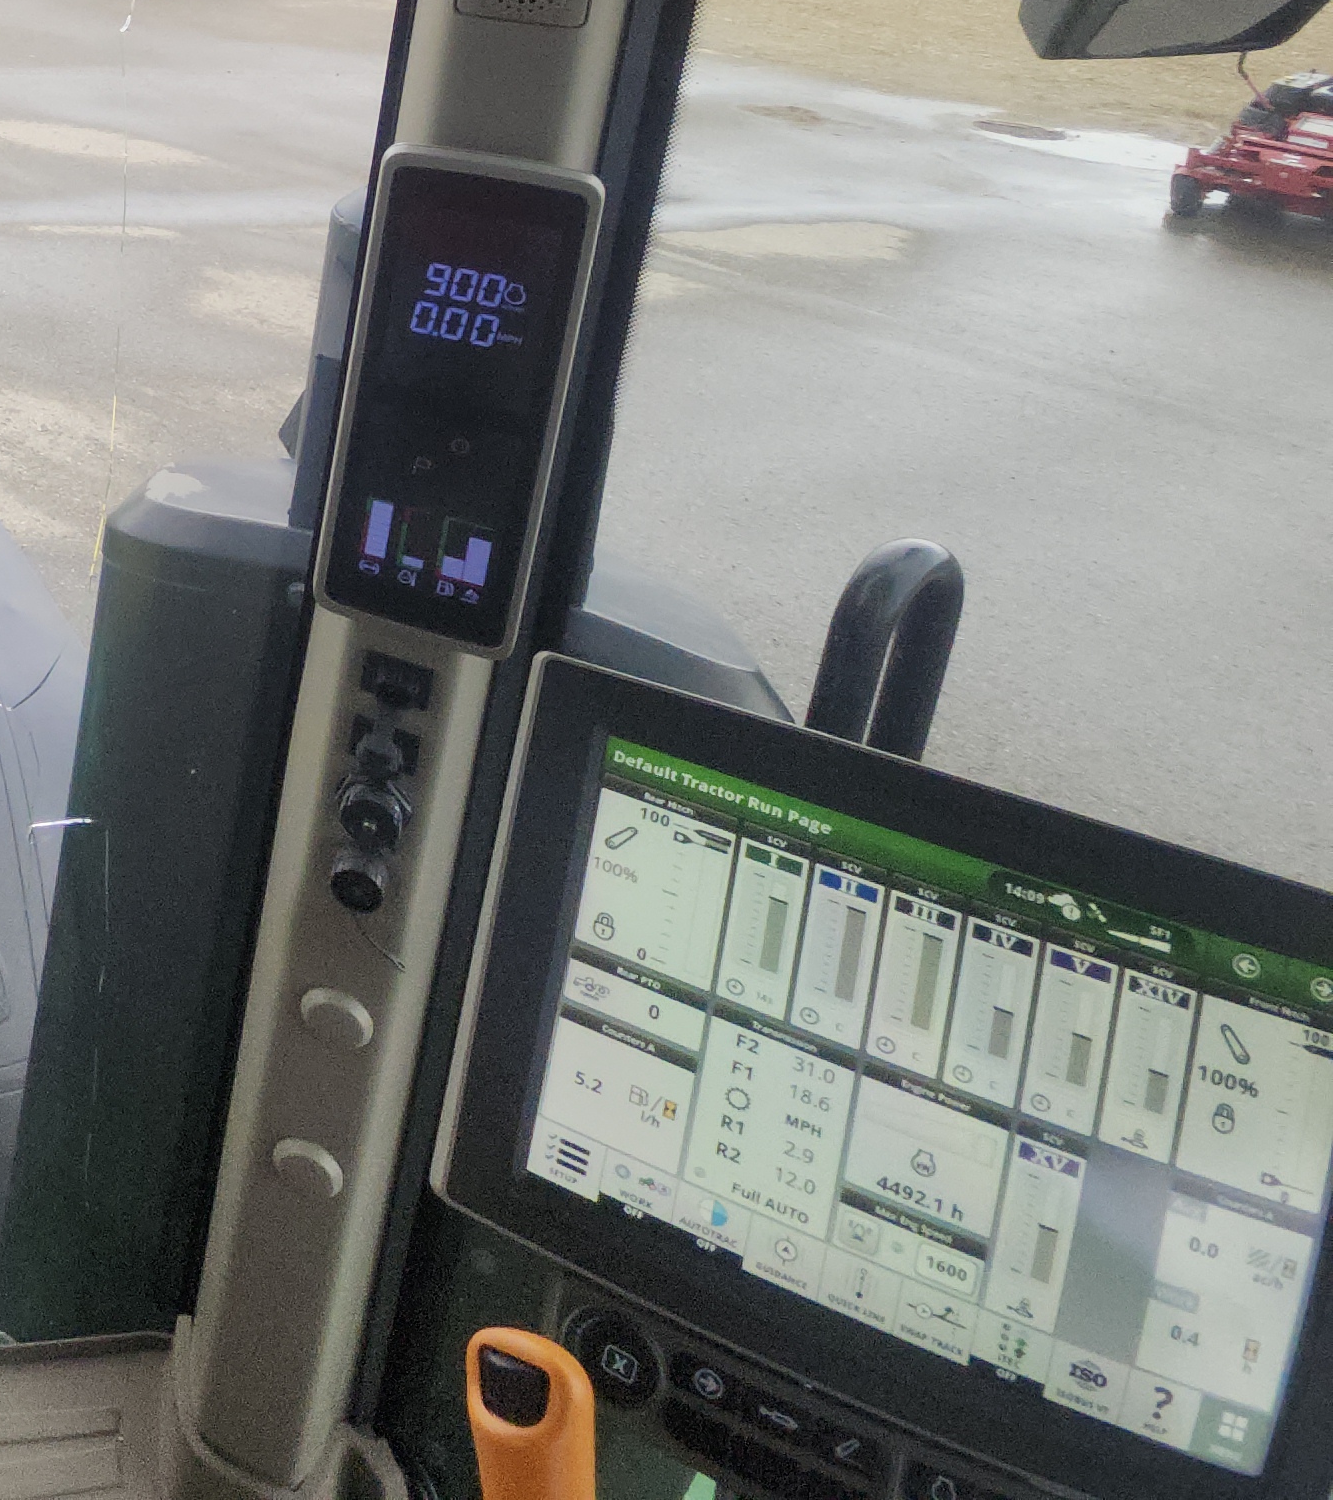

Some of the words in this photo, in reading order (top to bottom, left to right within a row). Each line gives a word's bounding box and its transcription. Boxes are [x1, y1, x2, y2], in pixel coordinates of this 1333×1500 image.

[424, 262, 507, 308] 900
[410, 301, 500, 347] 0.00
[614, 749, 677, 782] Default
[682, 773, 744, 804] Tractor
[748, 795, 783, 818] Run
[788, 809, 832, 835] Page
[640, 807, 670, 827] 100
[593, 856, 638, 884] 100%
[648, 1004, 660, 1020] 0
[1303, 1029, 1330, 1046] 100
[736, 1033, 760, 1055] F2
[792, 1056, 835, 1084] 31.0
[574, 1070, 604, 1095] 5.2
[731, 1060, 753, 1081] F1
[790, 1084, 830, 1113] 18.6
[1198, 1064, 1259, 1098] 100%
[720, 1114, 744, 1135] R1
[785, 1114, 822, 1138] MPH
[716, 1141, 740, 1164] R2
[783, 1141, 814, 1164] 2.9
[775, 1167, 816, 1195] 12.0
[731, 1182, 760, 1204] Full
[765, 1199, 809, 1224] AUTO
[876, 1176, 942, 1213] 4492.1
[951, 1203, 964, 1222] h
[1189, 1236, 1219, 1259] 0.0
[926, 1255, 968, 1281] 1600
[1069, 1362, 1108, 1388] ISO
